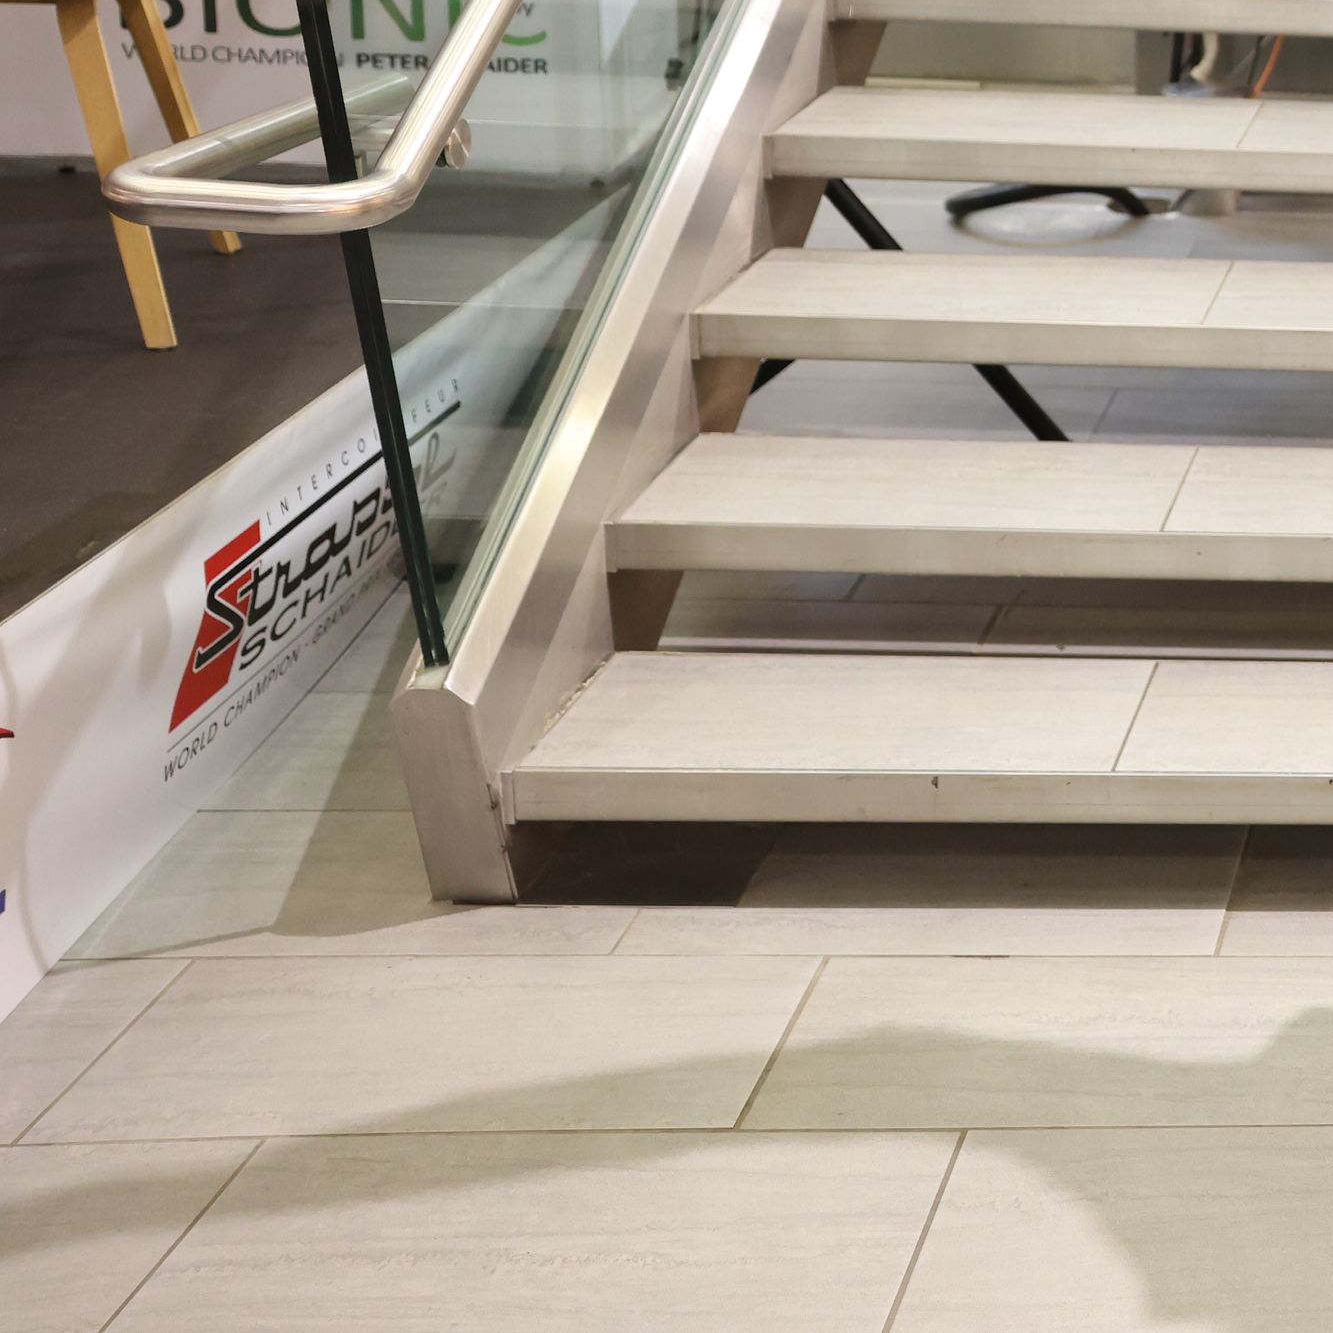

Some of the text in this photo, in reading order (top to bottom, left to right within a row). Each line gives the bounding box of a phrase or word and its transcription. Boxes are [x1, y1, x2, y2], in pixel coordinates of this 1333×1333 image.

[355, 51, 429, 72] PETER
[486, 54, 548, 75] AIDER
[265, 378, 460, 527] INTERCOIFEUR
[163, 721, 218, 783] WORLD
